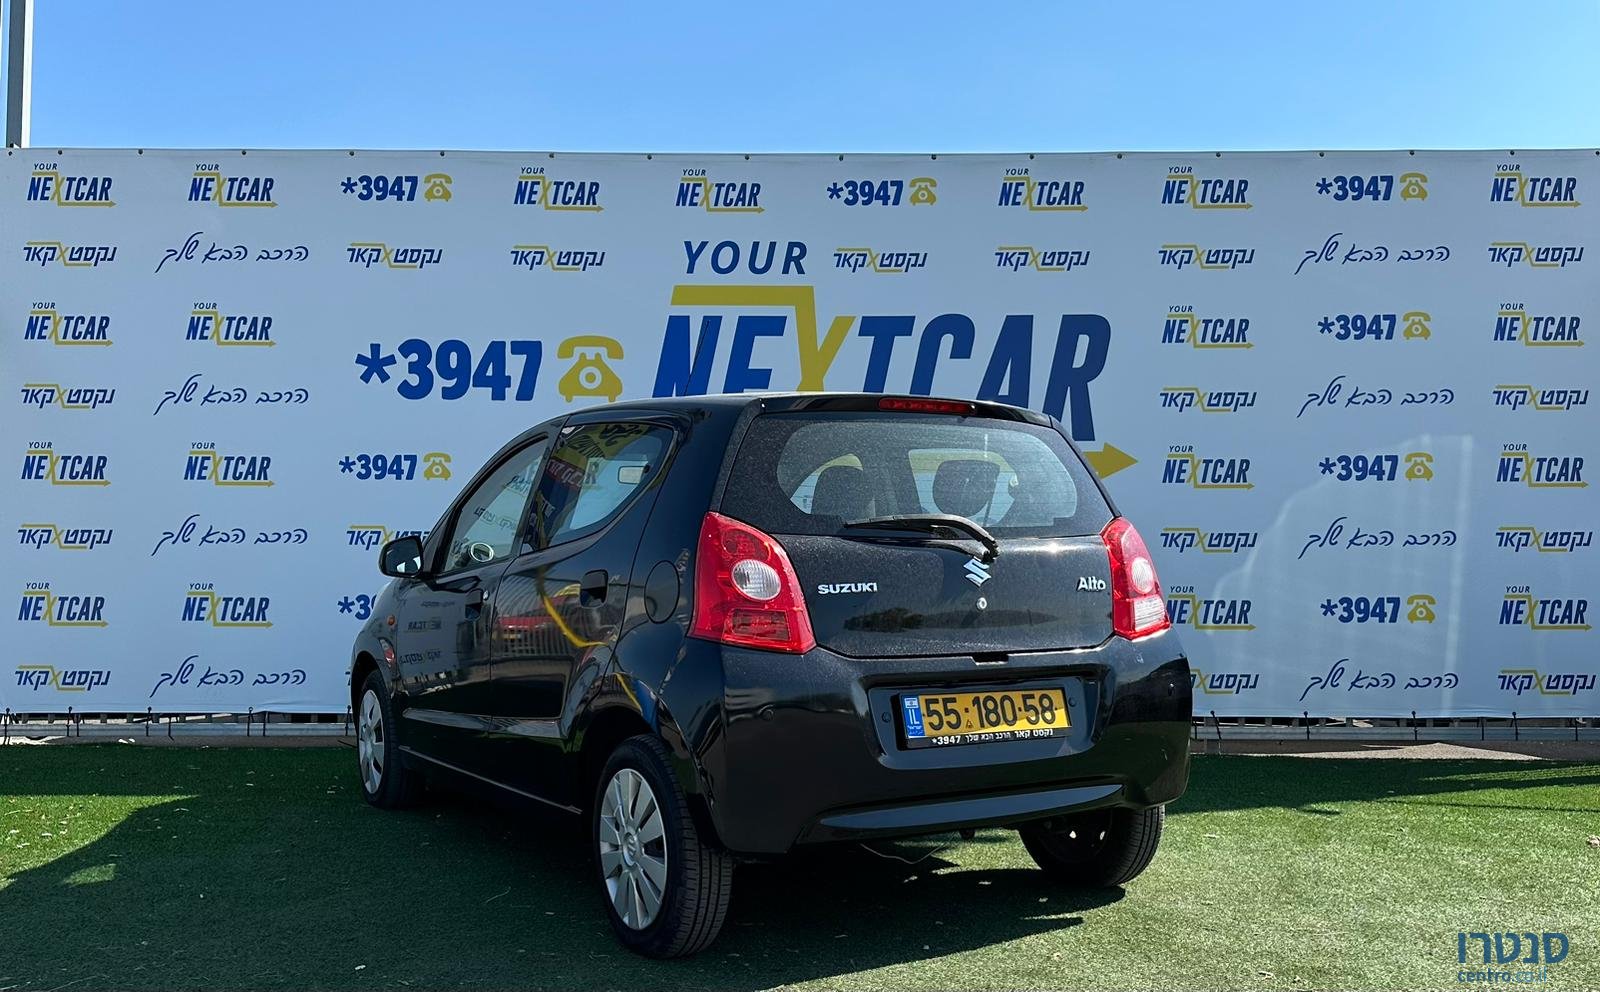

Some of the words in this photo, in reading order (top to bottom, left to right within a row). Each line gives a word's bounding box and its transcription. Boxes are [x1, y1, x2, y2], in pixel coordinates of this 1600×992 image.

[520, 167, 545, 175] YOUR
[682, 169, 707, 177] YOUR
[1005, 168, 1030, 176] YOUR
[1168, 166, 1193, 174] YOUR
[1496, 164, 1521, 172] YOUR
[27, 177, 112, 201] NEXTCAR
[188, 177, 274, 201] NEXTCAR
[514, 181, 599, 205] NEXTCAR
[676, 183, 761, 206] NEXTCAR
[998, 182, 1084, 206] NEXTCAR
[1162, 179, 1248, 204] NEXTCAR
[1491, 178, 1576, 201] NEXTCAR
[155, 232, 204, 273] שלך
[202, 243, 247, 263] הבא
[256, 246, 308, 261] הרכב
[684, 241, 807, 274] YOUR
[1295, 233, 1345, 275] שלך
[1342, 244, 1388, 264] הבא
[1397, 246, 1449, 262] הרכב
[32, 302, 56, 310] YOUR
[193, 302, 217, 310] YOUR
[1168, 305, 1193, 313] YOUR
[25, 316, 109, 340] NEXTCAR
[186, 316, 272, 340] NEXTCAR
[1162, 319, 1249, 343] NEXTCAR
[1494, 317, 1580, 341] NEXTCAR
[652, 313, 1111, 441] NEXTCAR
[154, 374, 204, 415] שלך
[201, 385, 247, 406] הבא
[256, 389, 308, 403] הרכב
[1297, 376, 1348, 417] שלך
[1345, 387, 1392, 407] הבא
[1401, 389, 1454, 405] הרכב
[29, 441, 52, 449] YOUR
[191, 442, 215, 450] YOUR
[1169, 445, 1194, 453] YOUR
[1503, 443, 1527, 451] YOUR
[21, 456, 107, 479] NEXTCAR
[184, 456, 271, 480] NEXTCAR
[1162, 459, 1250, 483] NEXTCAR
[1497, 457, 1583, 482] NEXTCAR
[152, 514, 201, 556] שלך
[199, 525, 245, 546] הבא
[254, 529, 307, 544] הרכב
[1298, 517, 1349, 559] שלך
[1346, 528, 1394, 549] הבא
[1403, 531, 1456, 547] הרכב
[26, 582, 50, 590] YOUR
[817, 582, 878, 595] SUZUKI
[1077, 576, 1107, 592] Alto
[18, 597, 104, 621] NEXTCAR
[182, 597, 269, 621] NEXTCAR
[1167, 599, 1252, 625] NEXTCAR
[1499, 600, 1587, 624] NEXTCAR
[150, 655, 200, 698] שלך
[197, 666, 244, 687] הבא
[253, 670, 306, 686] הרכב
[1299, 659, 1351, 701] שלך
[1348, 670, 1395, 691] הבא
[1404, 673, 1458, 689] הרכב
[1014, 730, 1031, 739] קאר
[1033, 728, 1053, 738] נקסט
